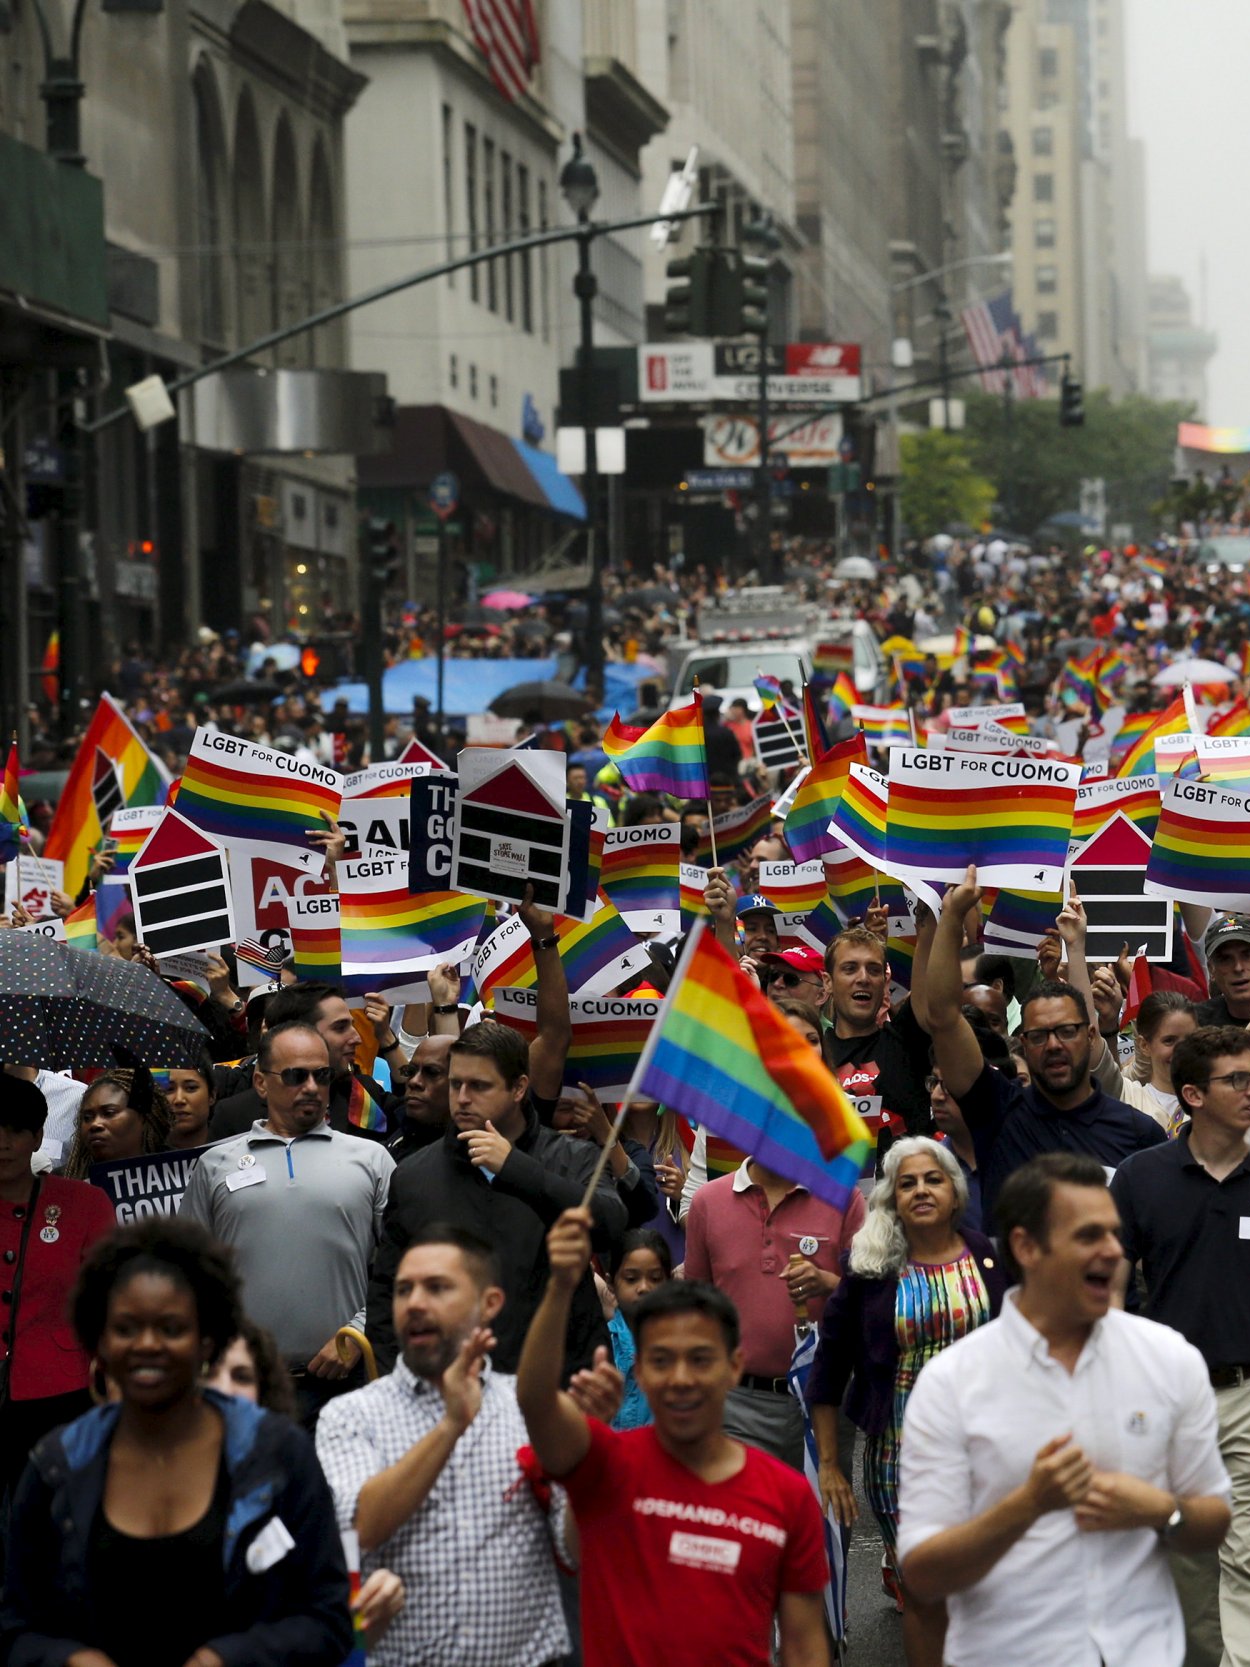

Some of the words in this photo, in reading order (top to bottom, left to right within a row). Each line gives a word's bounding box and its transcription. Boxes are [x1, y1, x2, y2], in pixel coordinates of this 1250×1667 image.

[952, 730, 981, 742] LGBT
[984, 734, 998, 742] FOR
[999, 735, 1042, 750] CUOMO
[1161, 735, 1191, 745] LGBT
[1204, 738, 1240, 750] LGBT
[202, 733, 249, 757] LGBT
[251, 749, 273, 763] FOR
[275, 756, 336, 786] CUOMO
[901, 752, 955, 772] LGBT
[960, 760, 988, 772] FOR
[991, 760, 1070, 782] CUOMO
[378, 765, 424, 779] CUOMO
[1097, 784, 1115, 793] FOR
[1116, 777, 1155, 792] CUOMO
[1173, 783, 1218, 805] LGBT
[1220, 795, 1242, 808] FOR
[118, 810, 145, 822] LGBT
[605, 827, 672, 845] CUOMO
[346, 859, 395, 879] LGBT
[681, 864, 705, 880] LGBT
[766, 865, 798, 876] LGBT
[801, 865, 818, 873] FOR
[297, 899, 341, 915] LGBT
[474, 937, 499, 978] LGBT
[500, 920, 522, 940] FOR
[502, 989, 537, 1006] LGB
[582, 1000, 659, 1017] CUOMO
